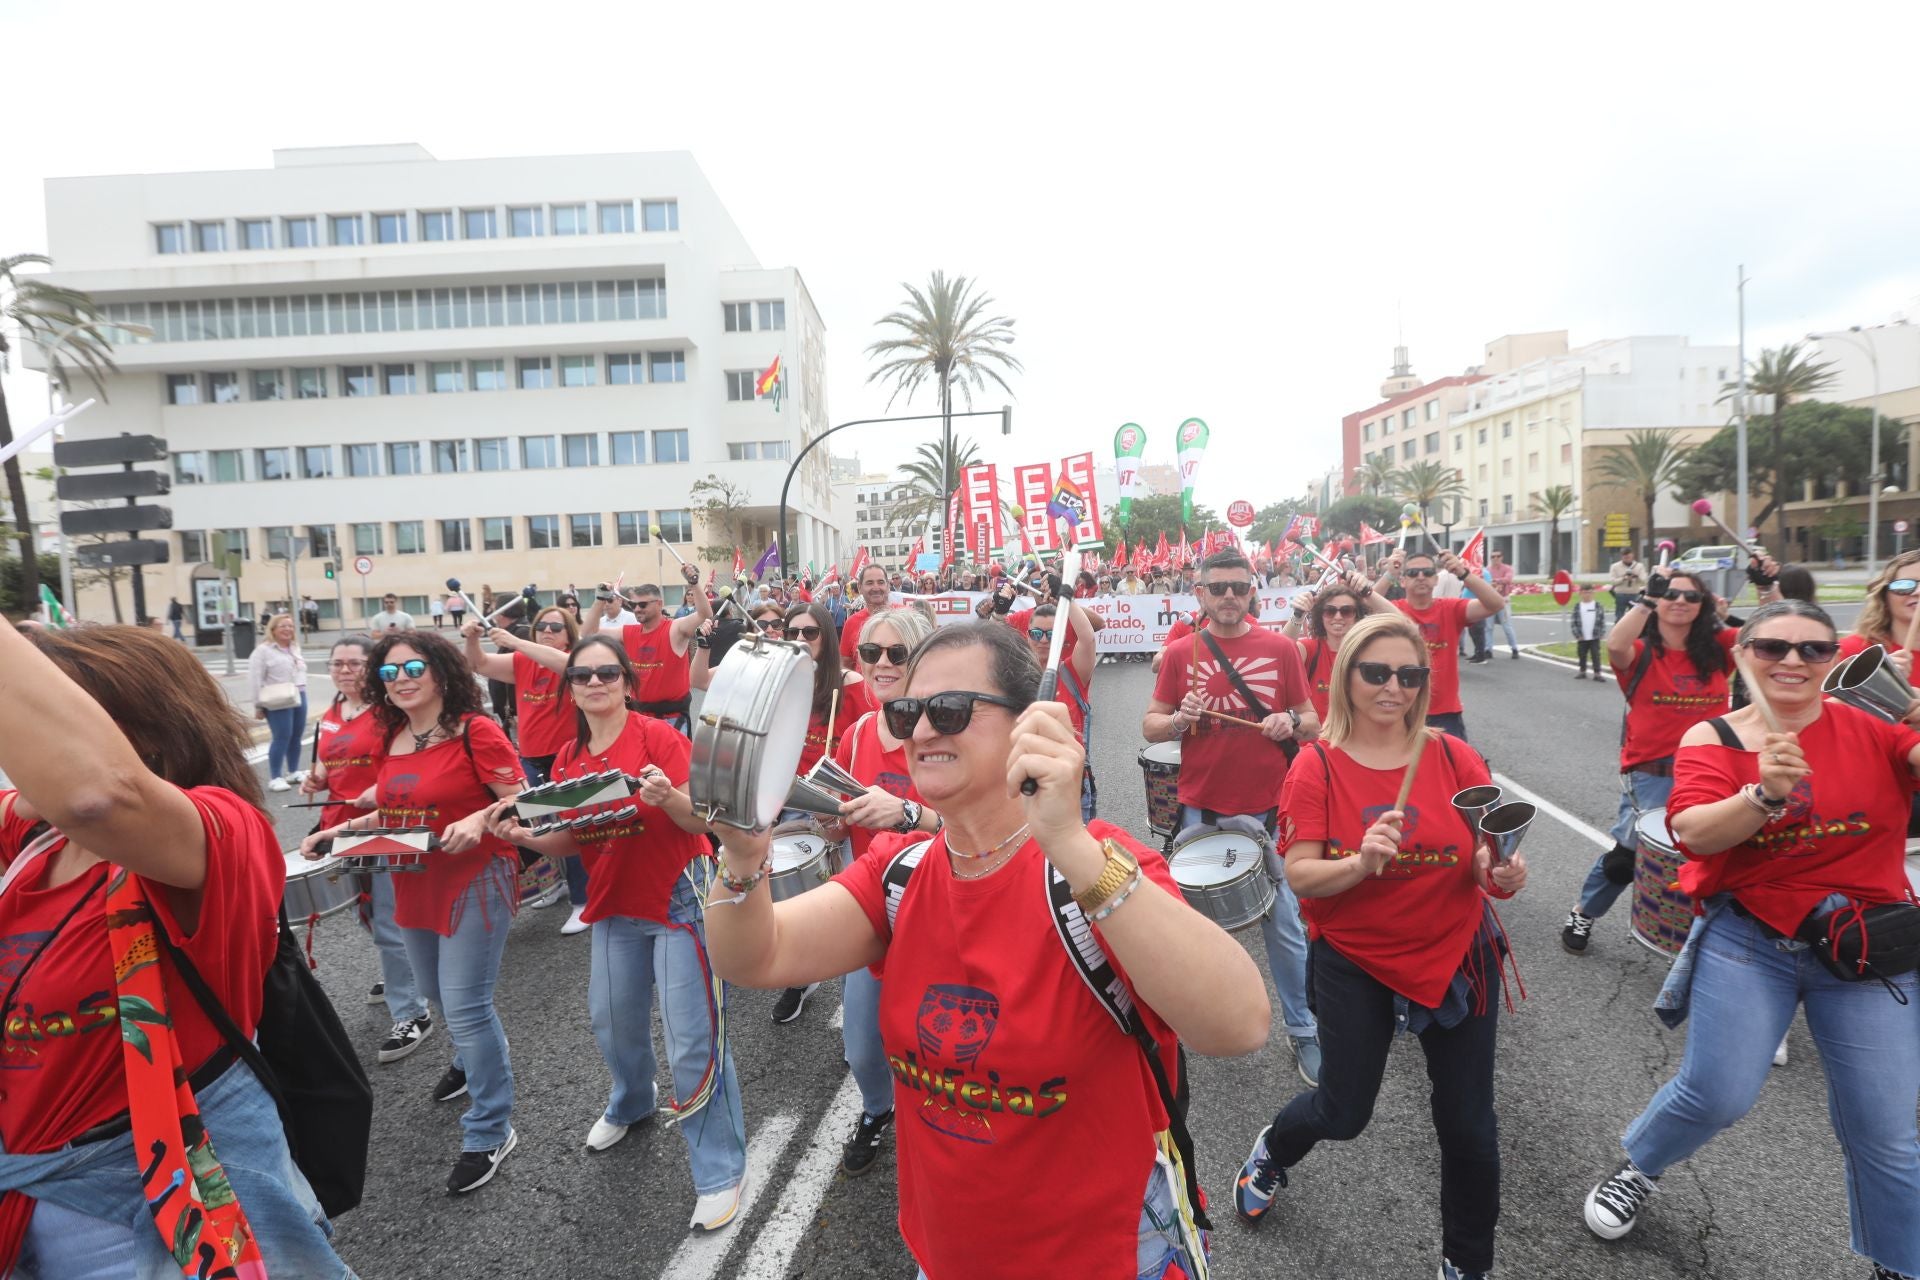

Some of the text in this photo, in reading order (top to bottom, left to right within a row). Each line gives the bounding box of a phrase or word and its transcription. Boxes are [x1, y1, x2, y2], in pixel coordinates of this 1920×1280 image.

[967, 466, 995, 548] CCO
[1231, 503, 1249, 513] UGT
[1117, 600, 1131, 613] lo
[1103, 616, 1145, 630] tado,
[1098, 631, 1144, 645] futuro
[1059, 900, 1106, 972] PUMA
